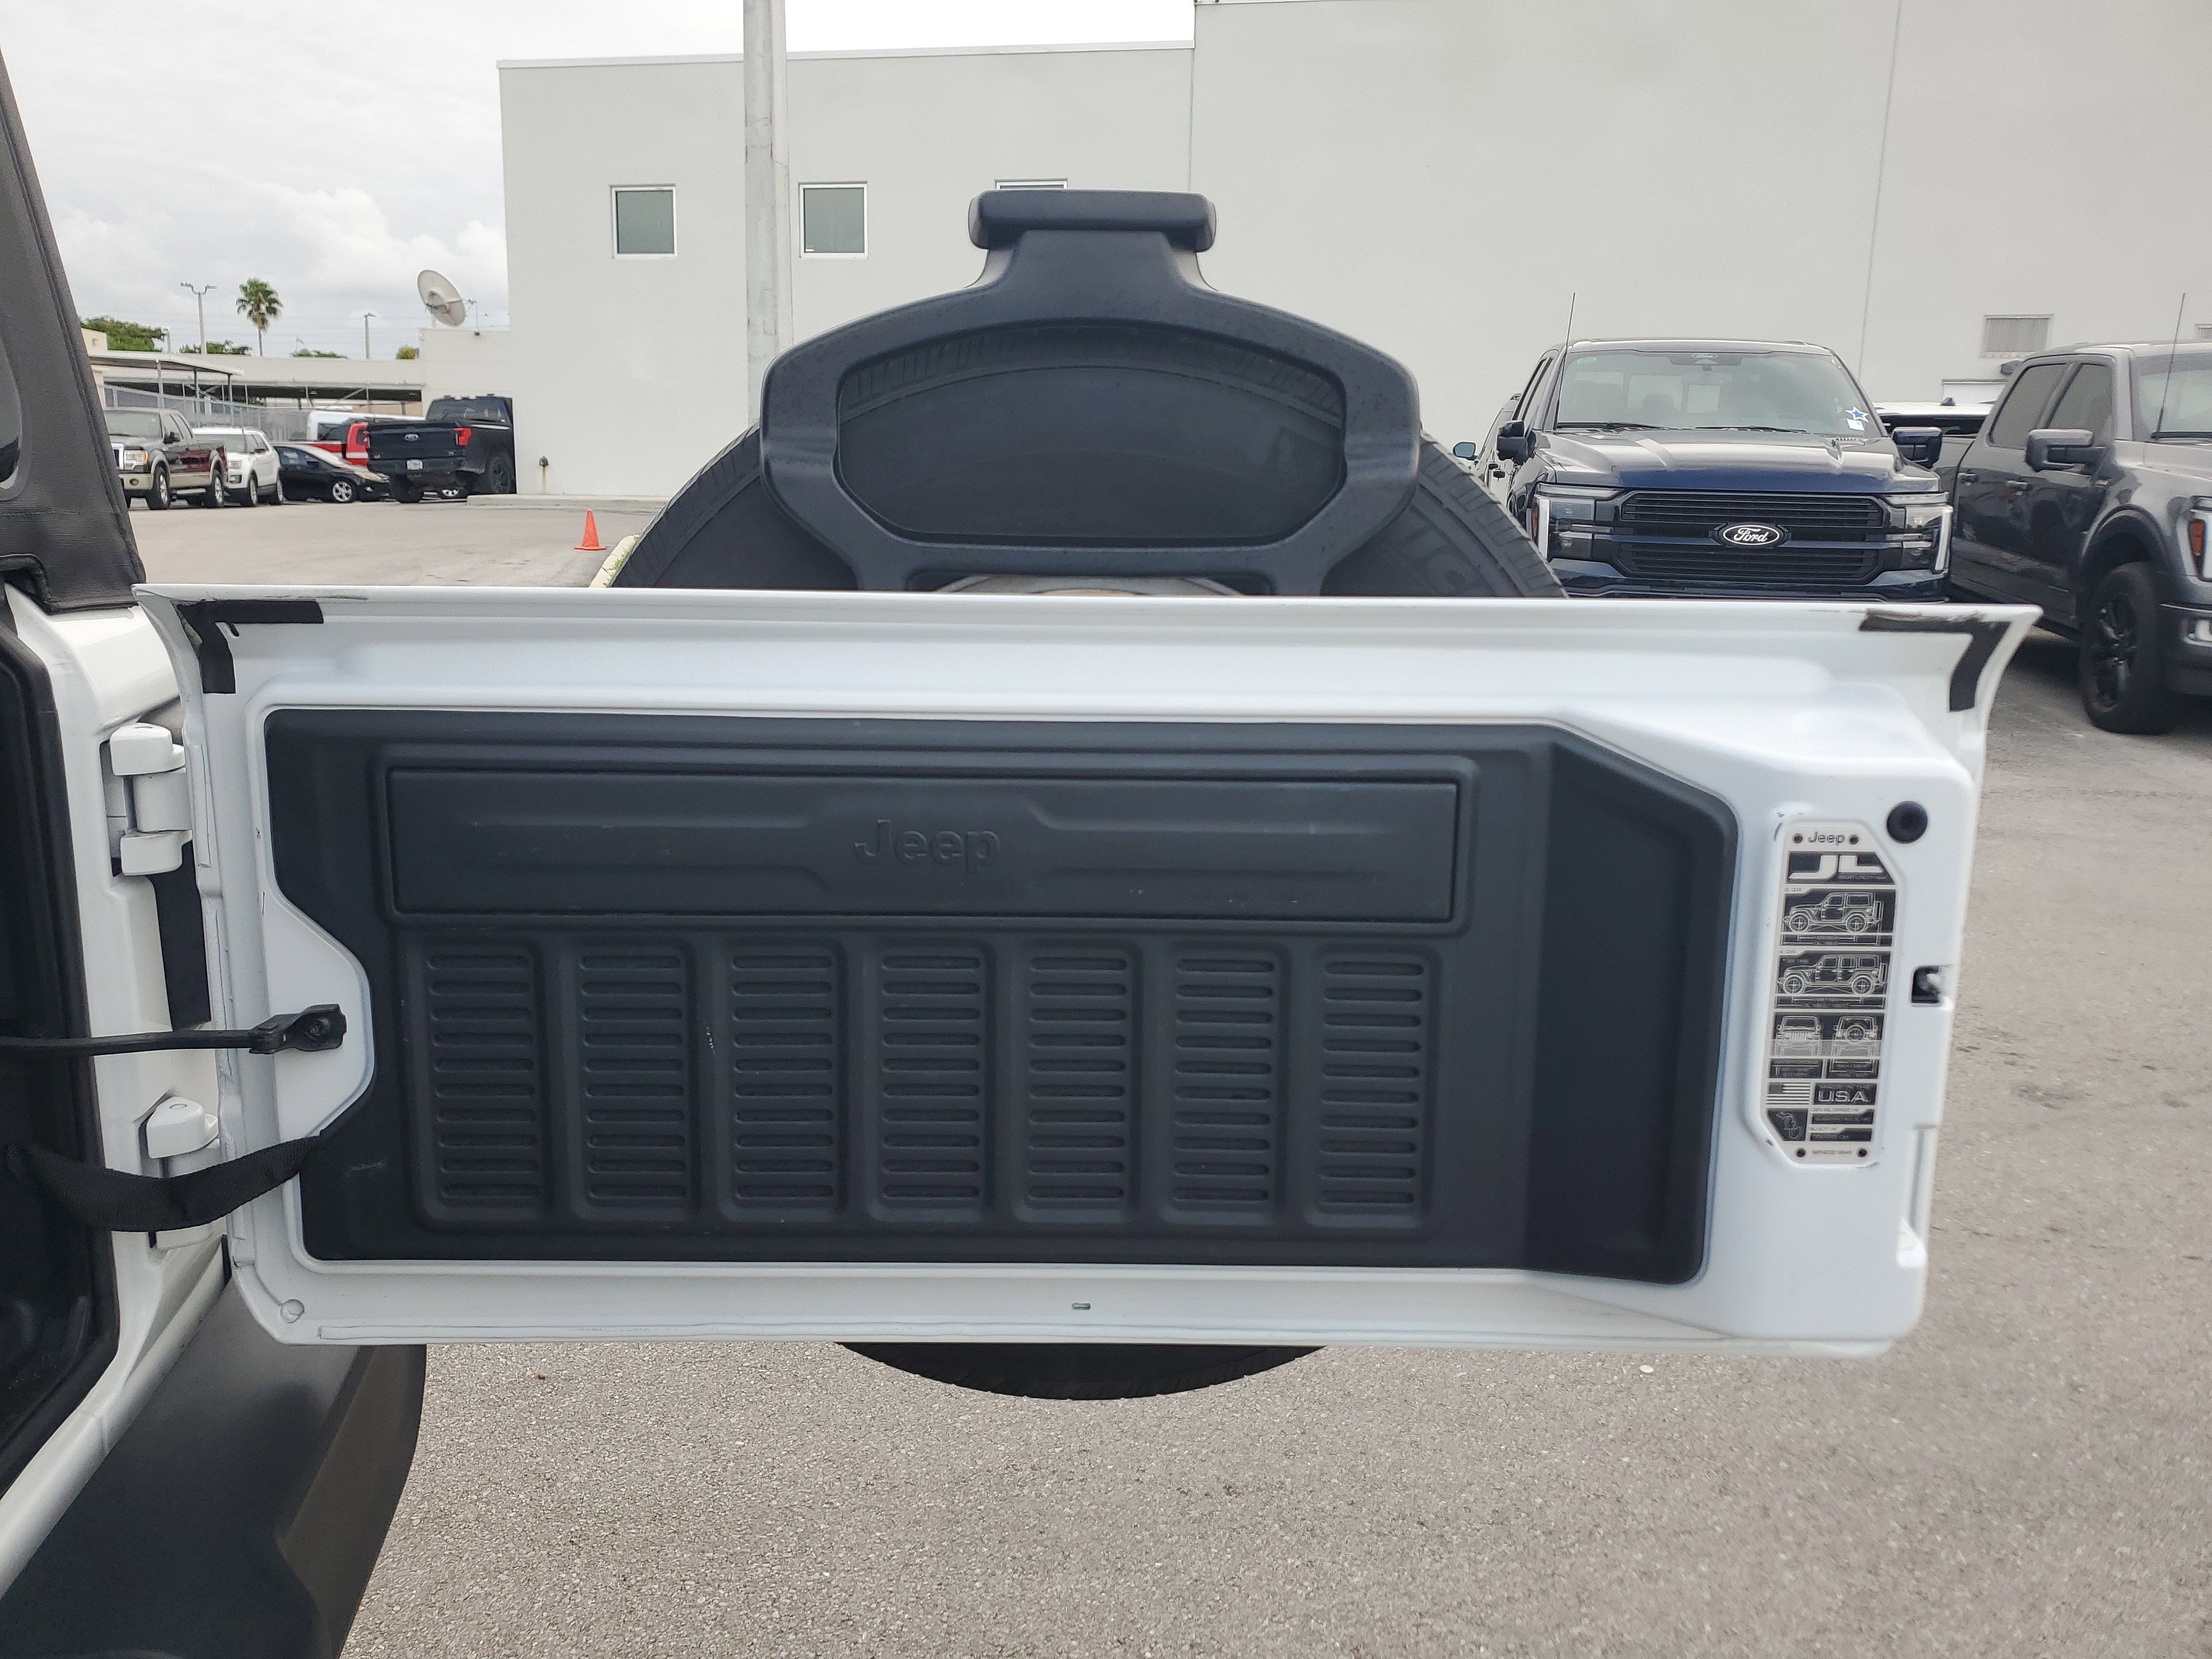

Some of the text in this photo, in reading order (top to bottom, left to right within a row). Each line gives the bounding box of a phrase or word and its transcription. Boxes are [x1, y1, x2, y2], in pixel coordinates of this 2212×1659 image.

[1733, 527, 1769, 543] Ford
[854, 818, 1001, 874] Jeep
[1807, 831, 1845, 845] Jeep
[1788, 854, 1884, 879] JL
